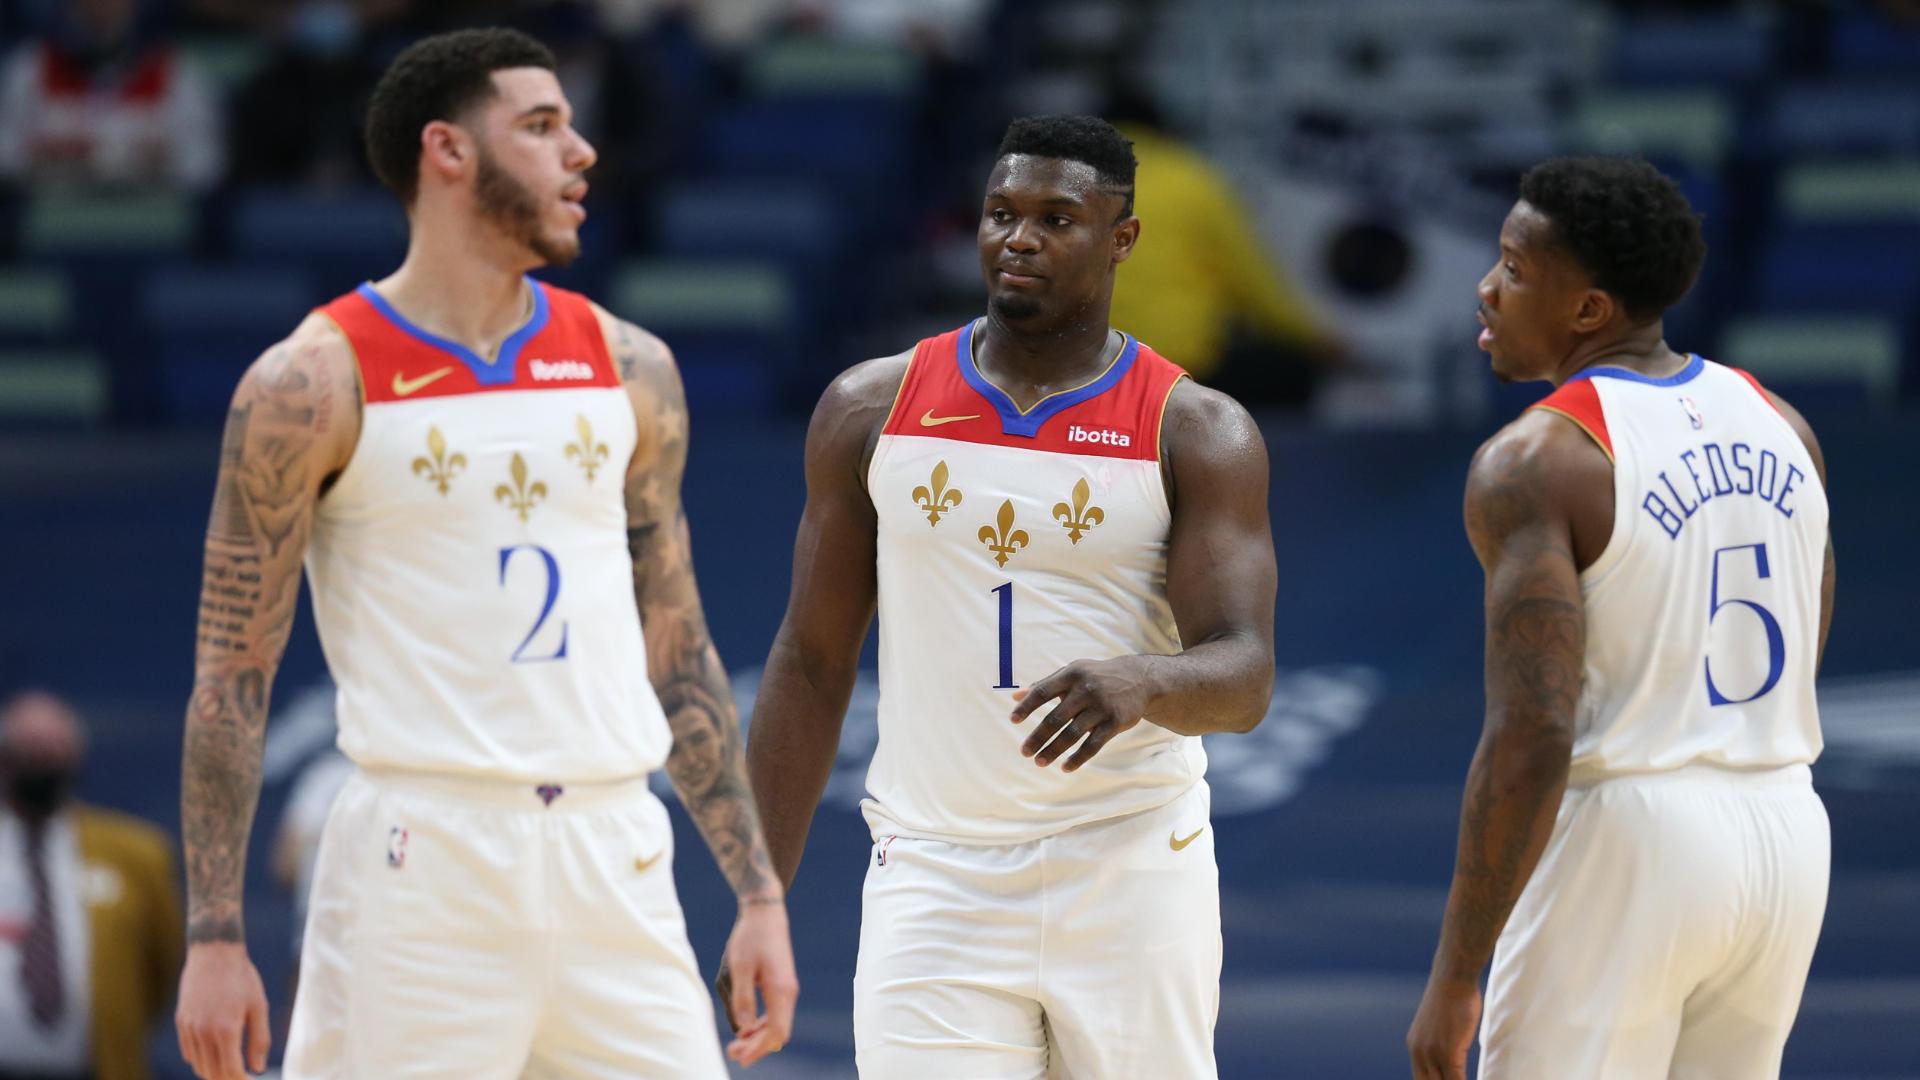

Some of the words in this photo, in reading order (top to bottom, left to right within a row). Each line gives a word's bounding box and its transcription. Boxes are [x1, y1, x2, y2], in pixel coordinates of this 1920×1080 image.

[1068, 425, 1131, 447] ibotta
[1642, 443, 1805, 540] BLEDSOE
[498, 544, 569, 663] 2
[991, 581, 1020, 689] 1
[1704, 542, 1785, 706] 5
